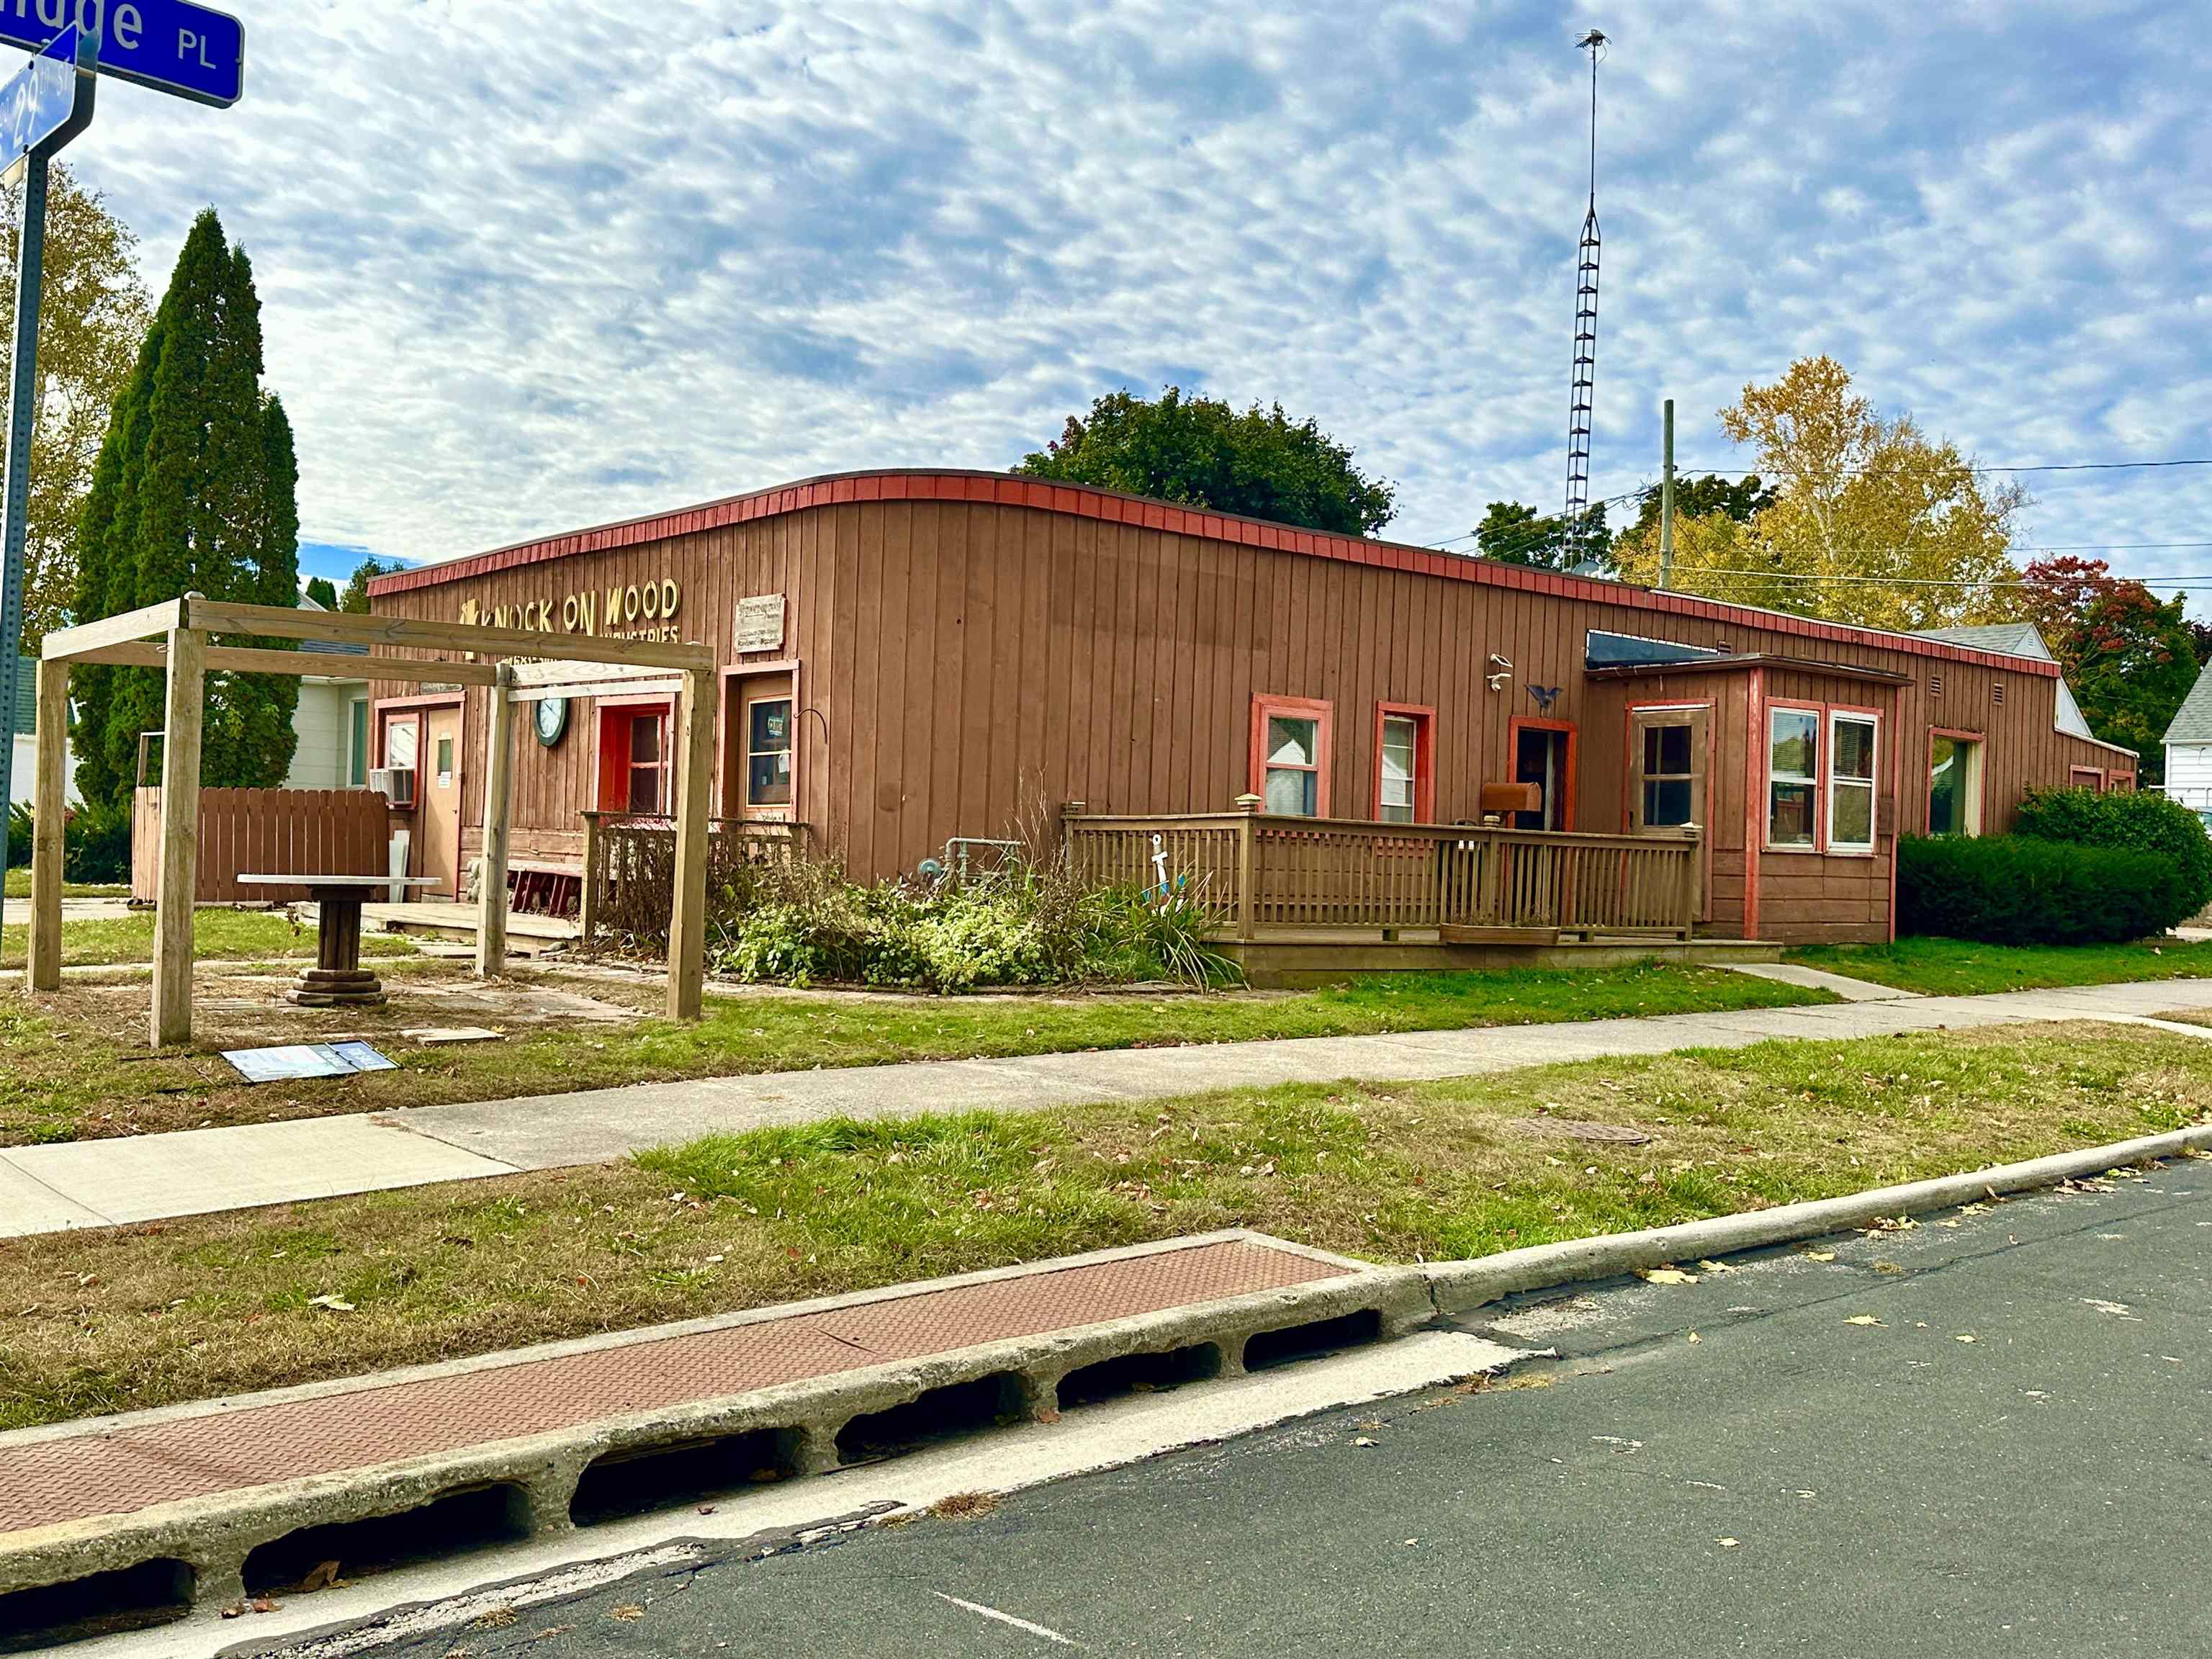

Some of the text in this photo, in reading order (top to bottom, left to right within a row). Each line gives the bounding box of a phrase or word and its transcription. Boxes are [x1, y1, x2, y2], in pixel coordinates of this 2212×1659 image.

[178, 29, 216, 69] PL
[564, 590, 598, 636] ON
[606, 578, 680, 622] WOOD
